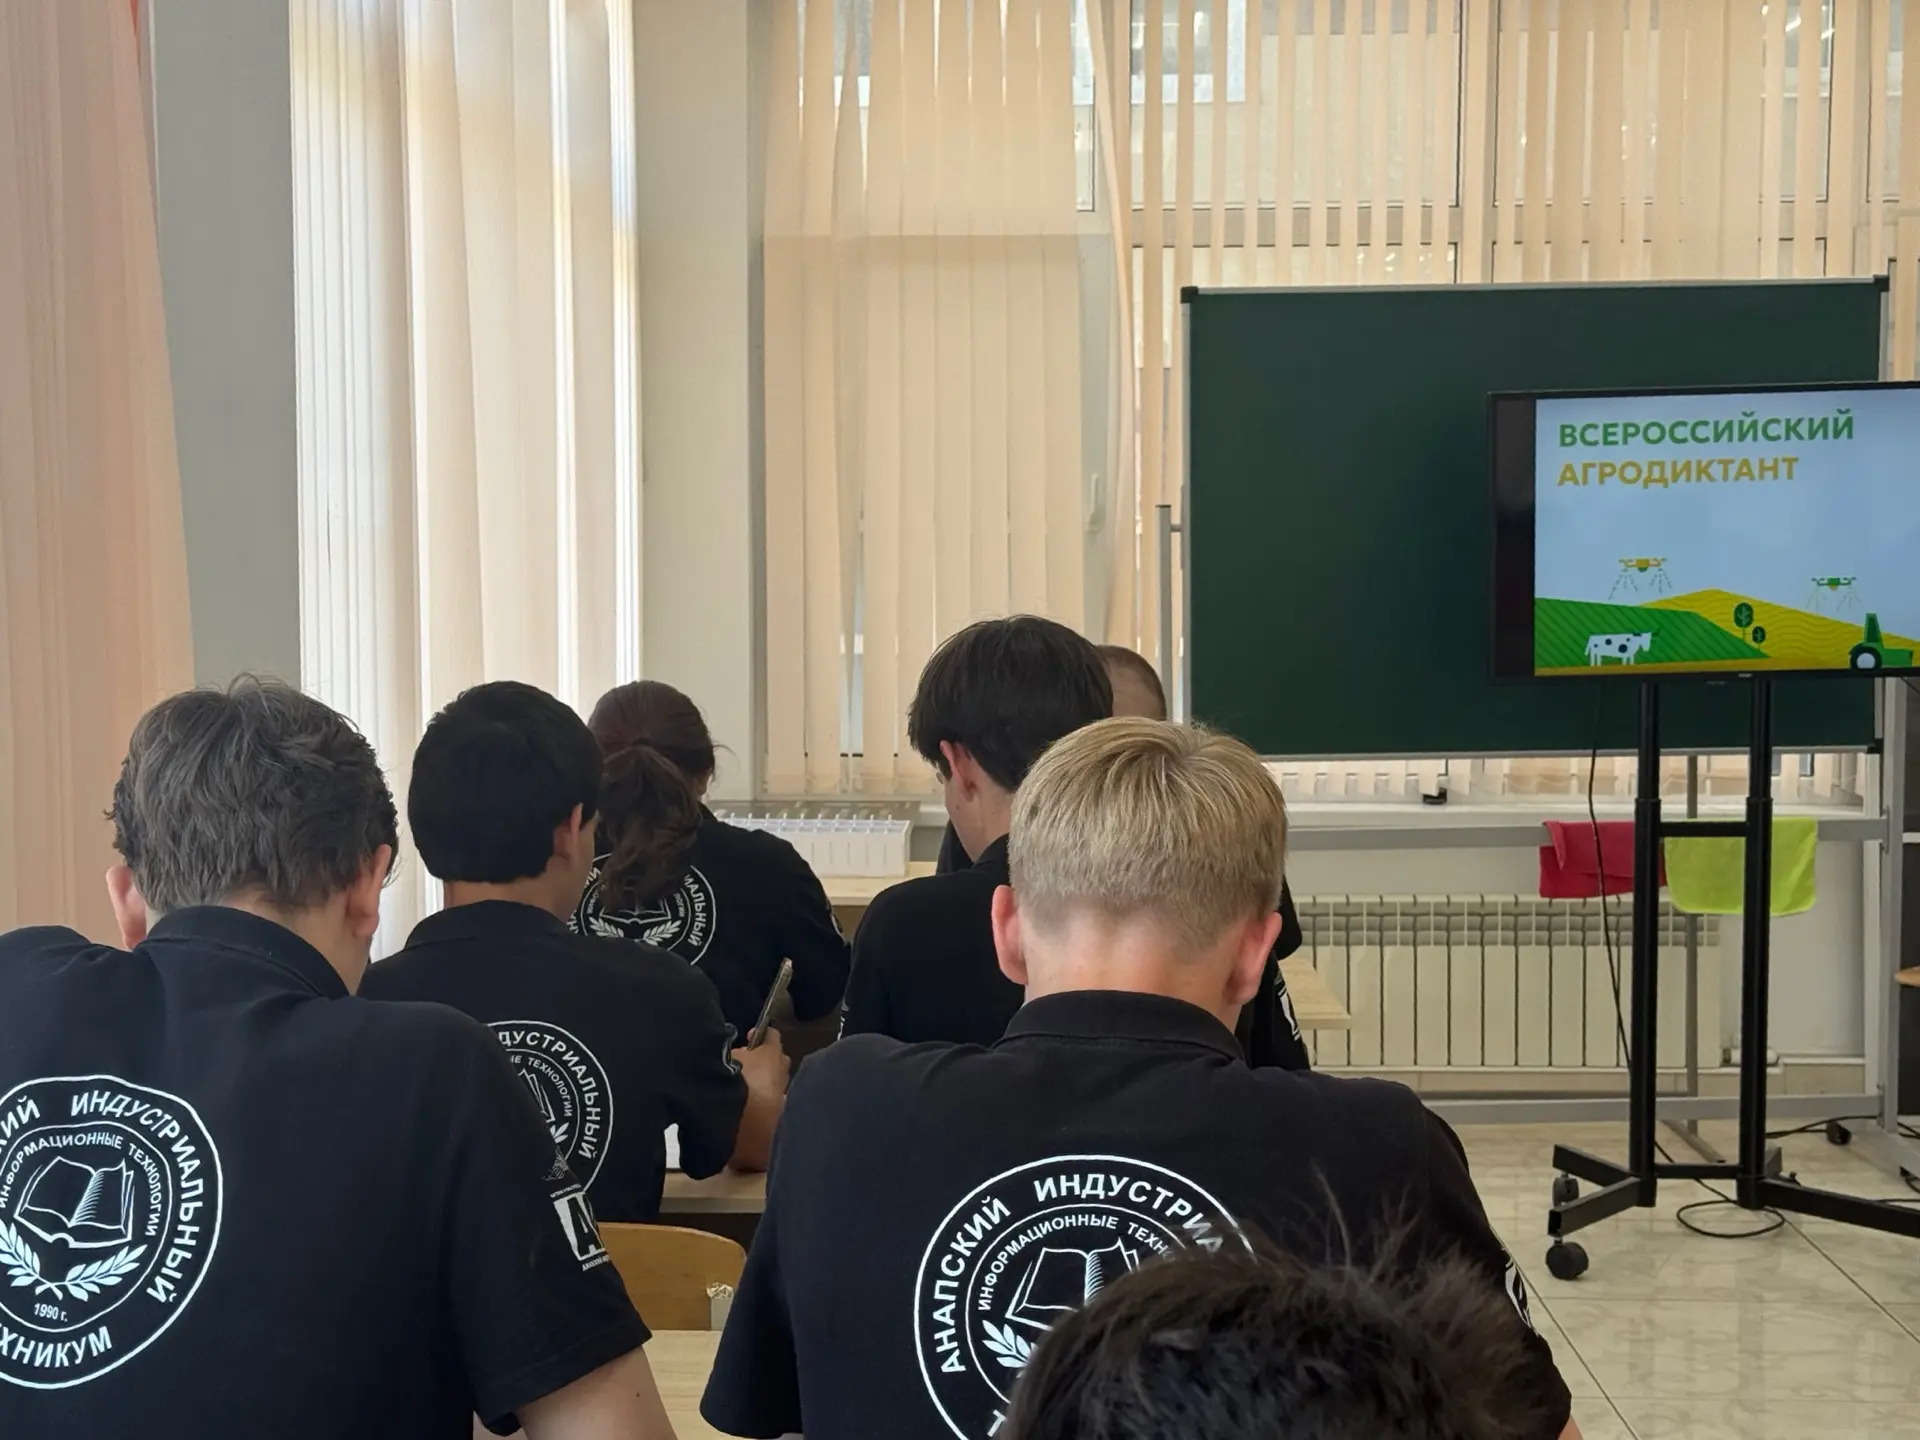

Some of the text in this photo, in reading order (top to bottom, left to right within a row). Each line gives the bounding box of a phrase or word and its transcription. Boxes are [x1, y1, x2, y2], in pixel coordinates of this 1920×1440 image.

[1558, 408, 1855, 448] ВСЕРОССИЙСКИЙ
[1557, 456, 1800, 489] АГРОДИКТАНТ
[527, 1057, 573, 1117] ТЕХНОЛОГИИ
[71, 1089, 204, 1302] ИНДУСТРИАЛЬНЫЙ
[127, 1142, 162, 1236] ТЕХНОЛОГИИ
[932, 1195, 1012, 1374] АНАПСКИЙ
[977, 1213, 1120, 1312] ИНФОРМАЦИОННЫЕ
[33, 1303, 60, 1321] 1990
